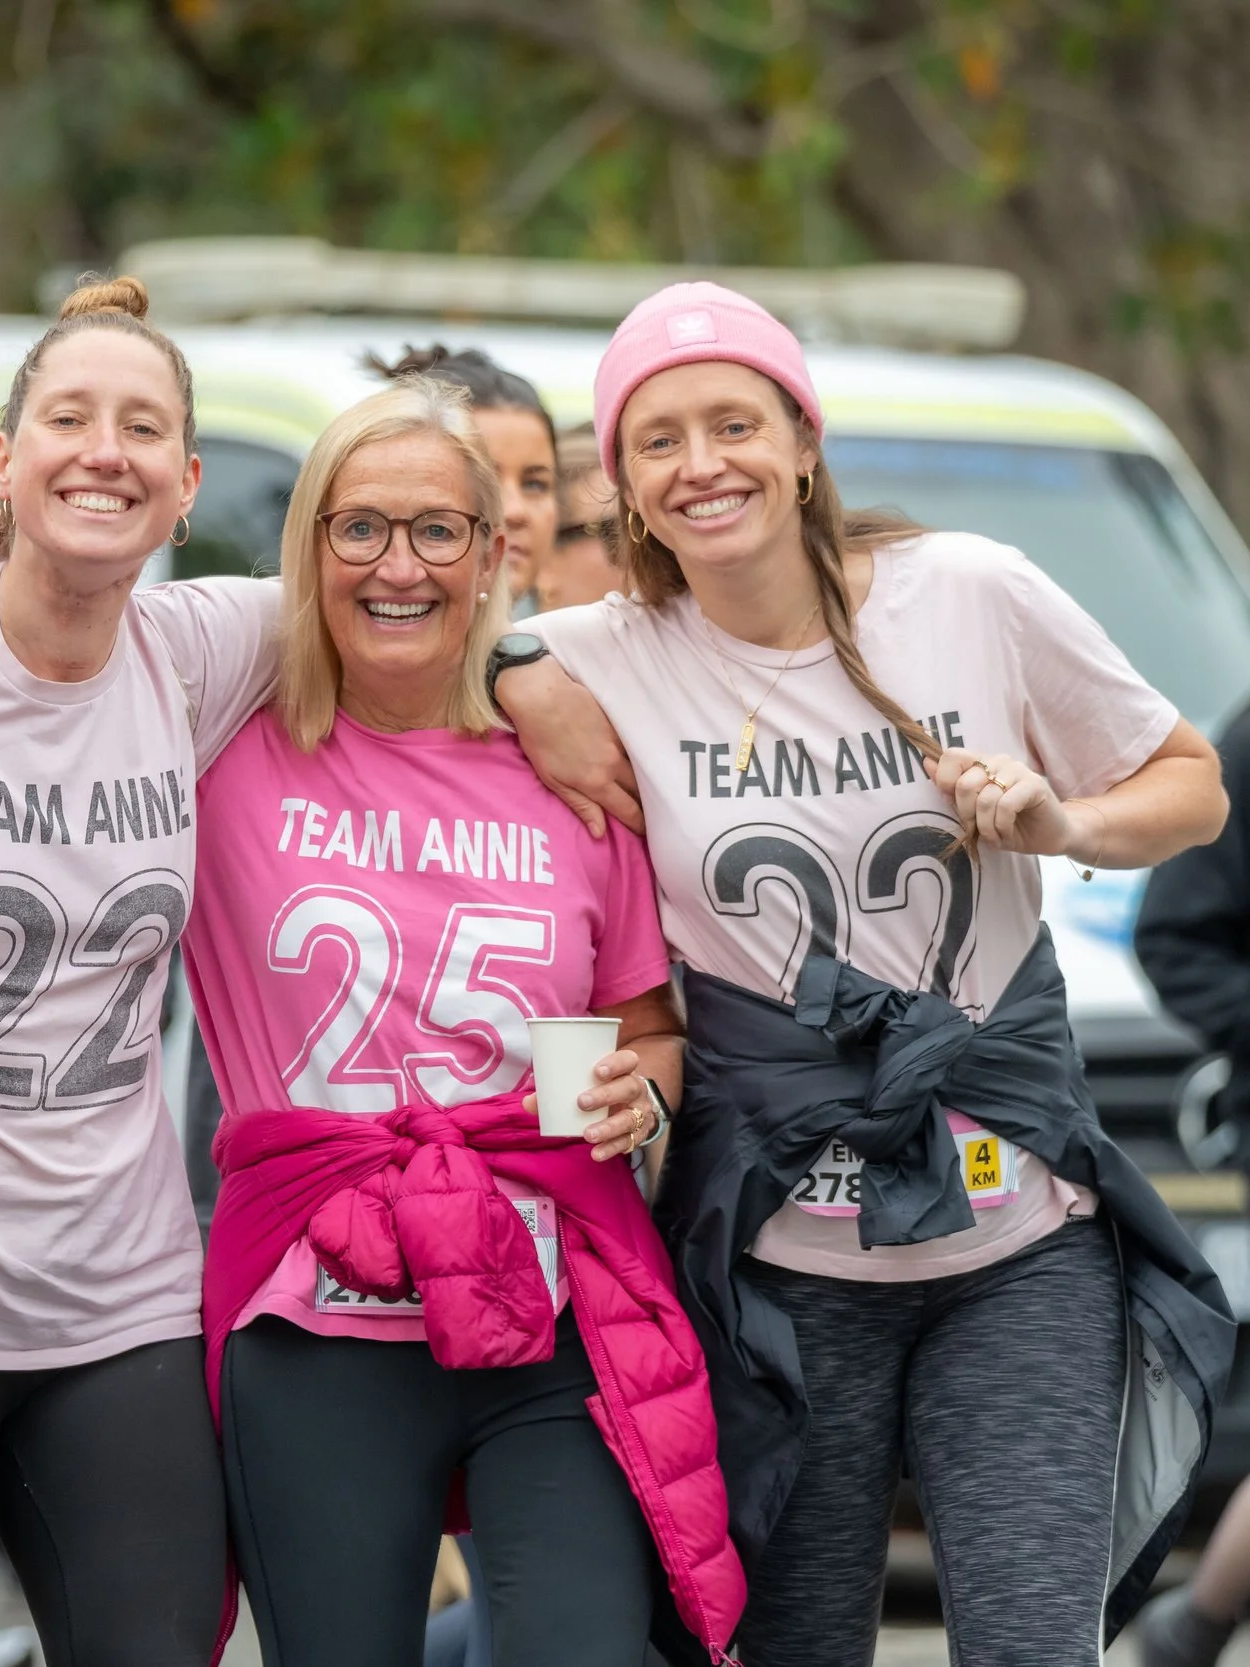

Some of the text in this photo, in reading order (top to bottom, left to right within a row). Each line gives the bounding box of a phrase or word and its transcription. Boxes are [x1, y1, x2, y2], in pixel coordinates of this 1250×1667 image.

[680, 738, 821, 798] TEAM
[277, 798, 554, 885] TEAM ANNIE
[702, 810, 982, 1012] 22
[267, 883, 555, 1114] 25
[972, 1170, 996, 1186] KM
[975, 1142, 991, 1165] 4
